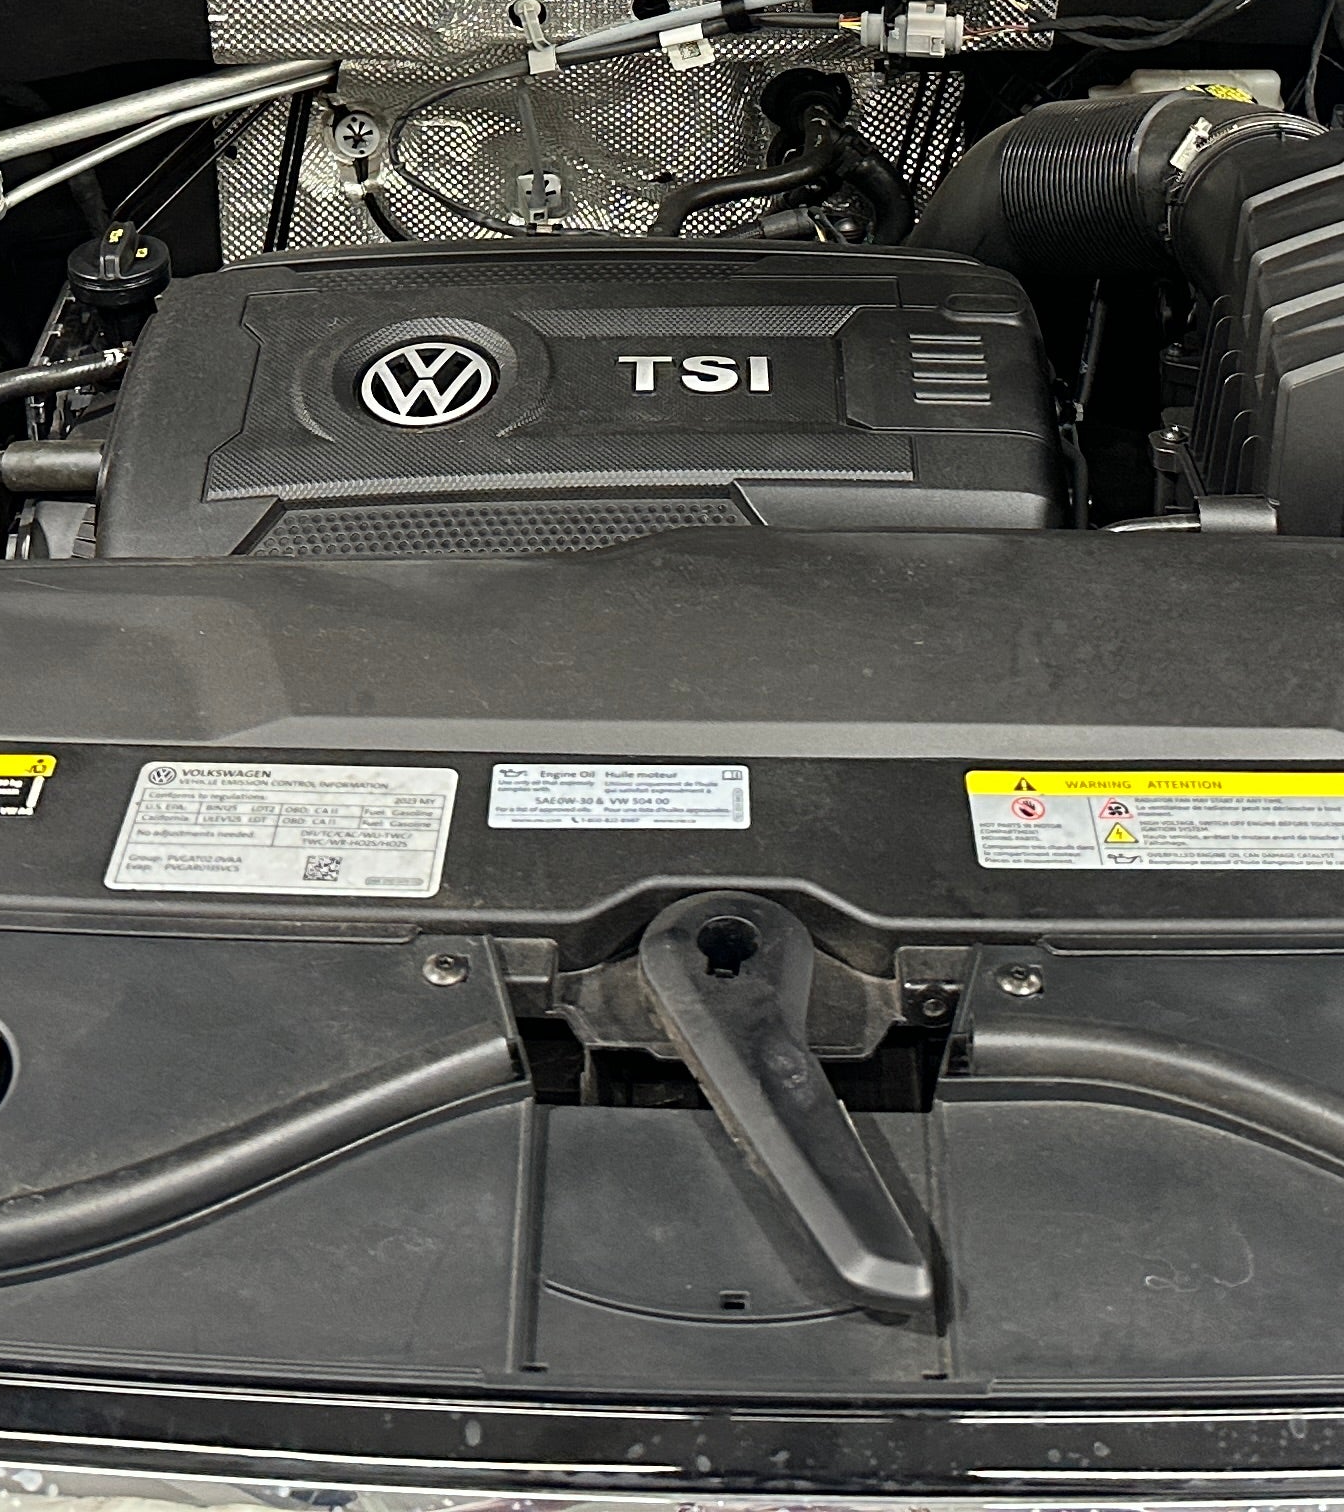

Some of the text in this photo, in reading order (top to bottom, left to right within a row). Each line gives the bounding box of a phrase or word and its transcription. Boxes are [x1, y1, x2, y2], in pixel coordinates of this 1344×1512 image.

[618, 355, 770, 393] TSI
[181, 769, 272, 779] VOLKSWAGEN
[540, 770, 595, 780] Engine Oil
[605, 771, 634, 779] Huile
[221, 779, 268, 787] EMISSION
[271, 780, 316, 788] CONTROL
[319, 781, 388, 789] INFORMATION
[1065, 780, 1222, 789] WARNING ATTENTION
[148, 792, 195, 800] Conforms
[198, 792, 208, 800] to
[391, 809, 434, 817] Gasoline
[389, 820, 432, 828] Gasoline
[153, 829, 215, 838] adjustments
